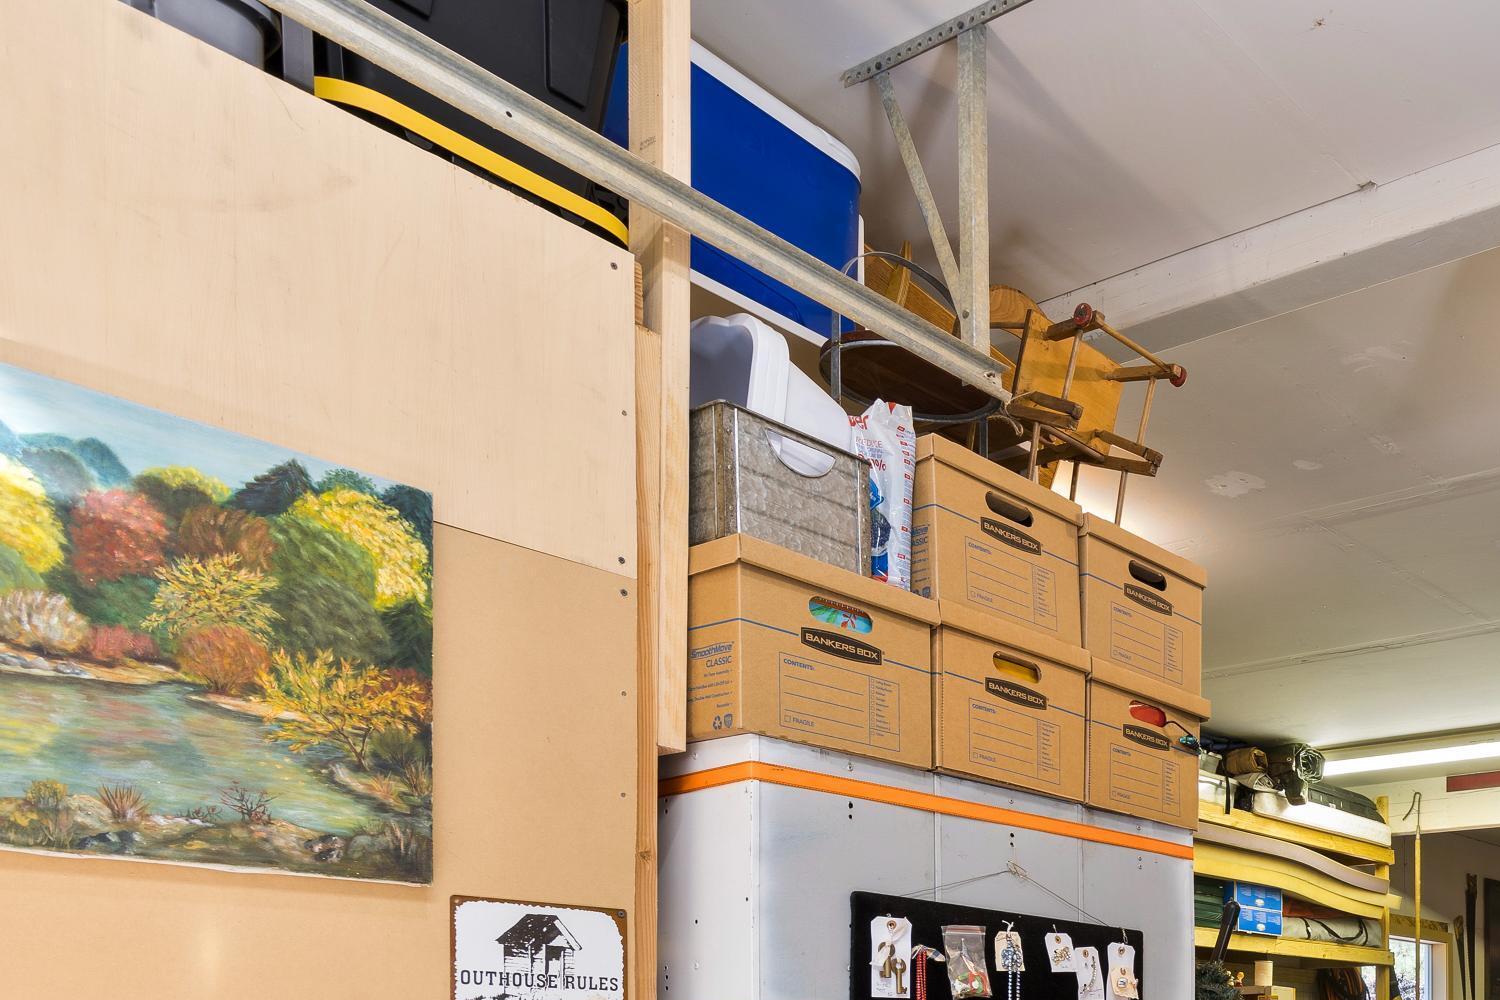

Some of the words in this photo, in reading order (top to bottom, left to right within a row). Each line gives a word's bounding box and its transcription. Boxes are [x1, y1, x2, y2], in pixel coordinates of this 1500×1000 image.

[983, 521, 1021, 544] BANKERS
[1022, 537, 1039, 551] BOX
[1126, 586, 1157, 607] BANKERS
[1157, 599, 1171, 612] BOX
[805, 632, 856, 654] BANKERS
[856, 647, 878, 660] BOX
[705, 655, 733, 668] CLASSIC
[988, 682, 1027, 700] BANKERS
[1027, 694, 1044, 705] BOX
[792, 716, 816, 727] FRAGILE
[1125, 727, 1156, 744] BANKERS
[1155, 735, 1169, 747] BOX
[460, 969, 558, 990] OUTHOUSE
[564, 974, 619, 992] RULES
